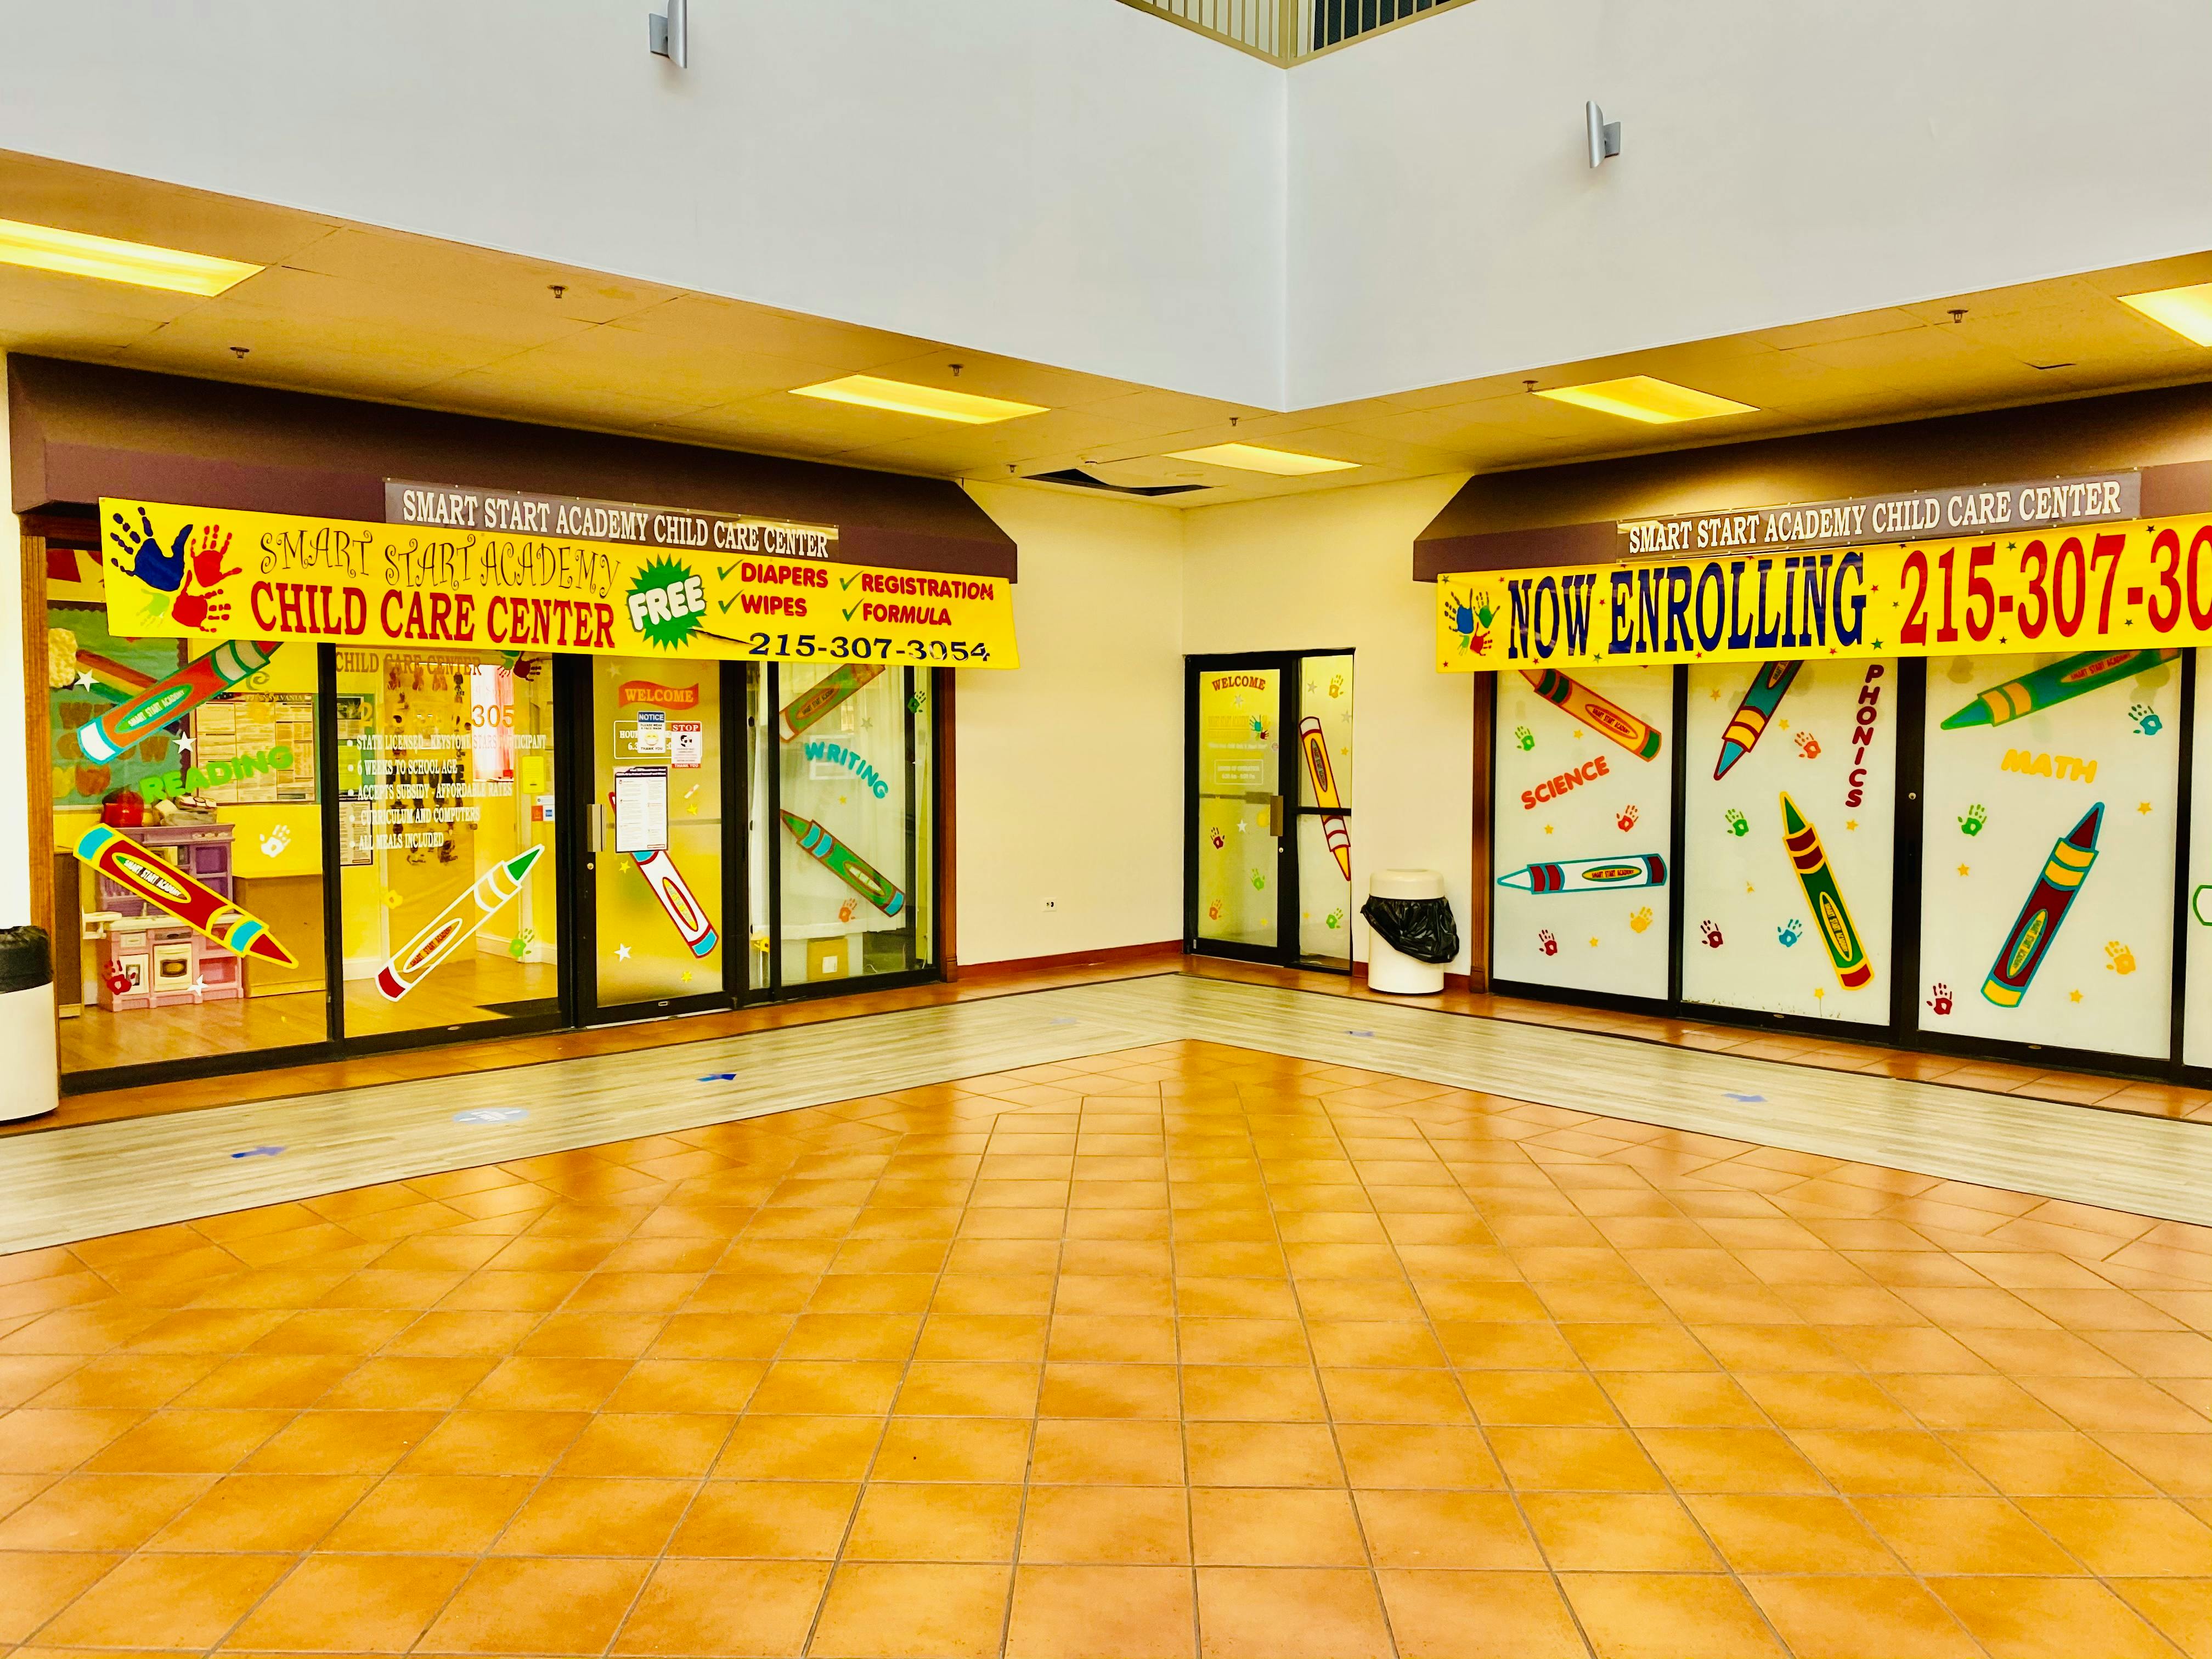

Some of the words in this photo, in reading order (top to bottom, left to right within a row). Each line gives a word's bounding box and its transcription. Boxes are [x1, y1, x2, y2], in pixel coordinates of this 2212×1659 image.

[403, 489, 478, 527] SMART
[484, 498, 550, 533] START
[556, 504, 648, 542] ACADEMY
[654, 514, 708, 548] CHILD
[714, 521, 759, 552] CARE
[764, 527, 829, 558] CENTER
[1630, 520, 1692, 554] SMART
[1697, 514, 1759, 548] START
[1764, 505, 1866, 542] ACADEMY
[1872, 498, 1940, 534] CHILD
[1948, 491, 2011, 527] CARE
[2019, 481, 2121, 520] CENTER
[260, 527, 373, 578] SMART
[385, 533, 475, 591] START
[481, 541, 620, 599] ACADEMY
[741, 562, 828, 589] DIAPERS
[861, 574, 994, 600] REGISTRATION
[250, 581, 367, 636] CHILD
[381, 589, 475, 641] CARE
[487, 595, 615, 648] CENTER
[629, 576, 707, 631] FREE
[741, 594, 807, 617] WIPES
[863, 603, 951, 626] FORMULA
[1508, 573, 1596, 659] NOW
[1608, 551, 1866, 654] ENROLLING
[749, 633, 990, 662] 215-307-3054
[336, 652, 379, 673] CHILD
[385, 653, 421, 675] CARE
[427, 654, 481, 676] CENTER
[624, 689, 694, 703] WELCOME
[1211, 676, 1266, 691] WELCOME
[128, 712, 146, 727] SMART
[145, 702, 162, 717] START
[161, 690, 184, 708] ACADEMY
[357, 735, 383, 750] STATE
[385, 735, 423, 750] LICENSED
[431, 734, 471, 749] KEYSTONE
[1846, 664, 1884, 807] PHONICS
[139, 746, 294, 804] READING
[357, 760, 362, 776] 6
[364, 759, 393, 775] WEEKS
[395, 759, 406, 775] TO
[408, 759, 439, 775] SCHOOL
[442, 759, 458, 774] AGE
[805, 741, 888, 799] WRITING
[2001, 749, 2097, 783] MATH
[357, 783, 394, 800] ACCEPTS
[396, 783, 430, 799] SUBSIDY
[436, 783, 487, 798] AFFORDABLE
[489, 782, 512, 797] RATES
[1521, 755, 1610, 810] SCIENCE
[360, 808, 414, 825] CURRICULUM
[415, 808, 432, 823] AND
[433, 807, 480, 822] COMPUTERS
[359, 834, 373, 850] ALL
[376, 833, 403, 849] MEALS
[405, 832, 444, 849] INCLUDED
[124, 860, 143, 874] SMART
[140, 870, 159, 884] START
[156, 879, 182, 896] ACADEMY
